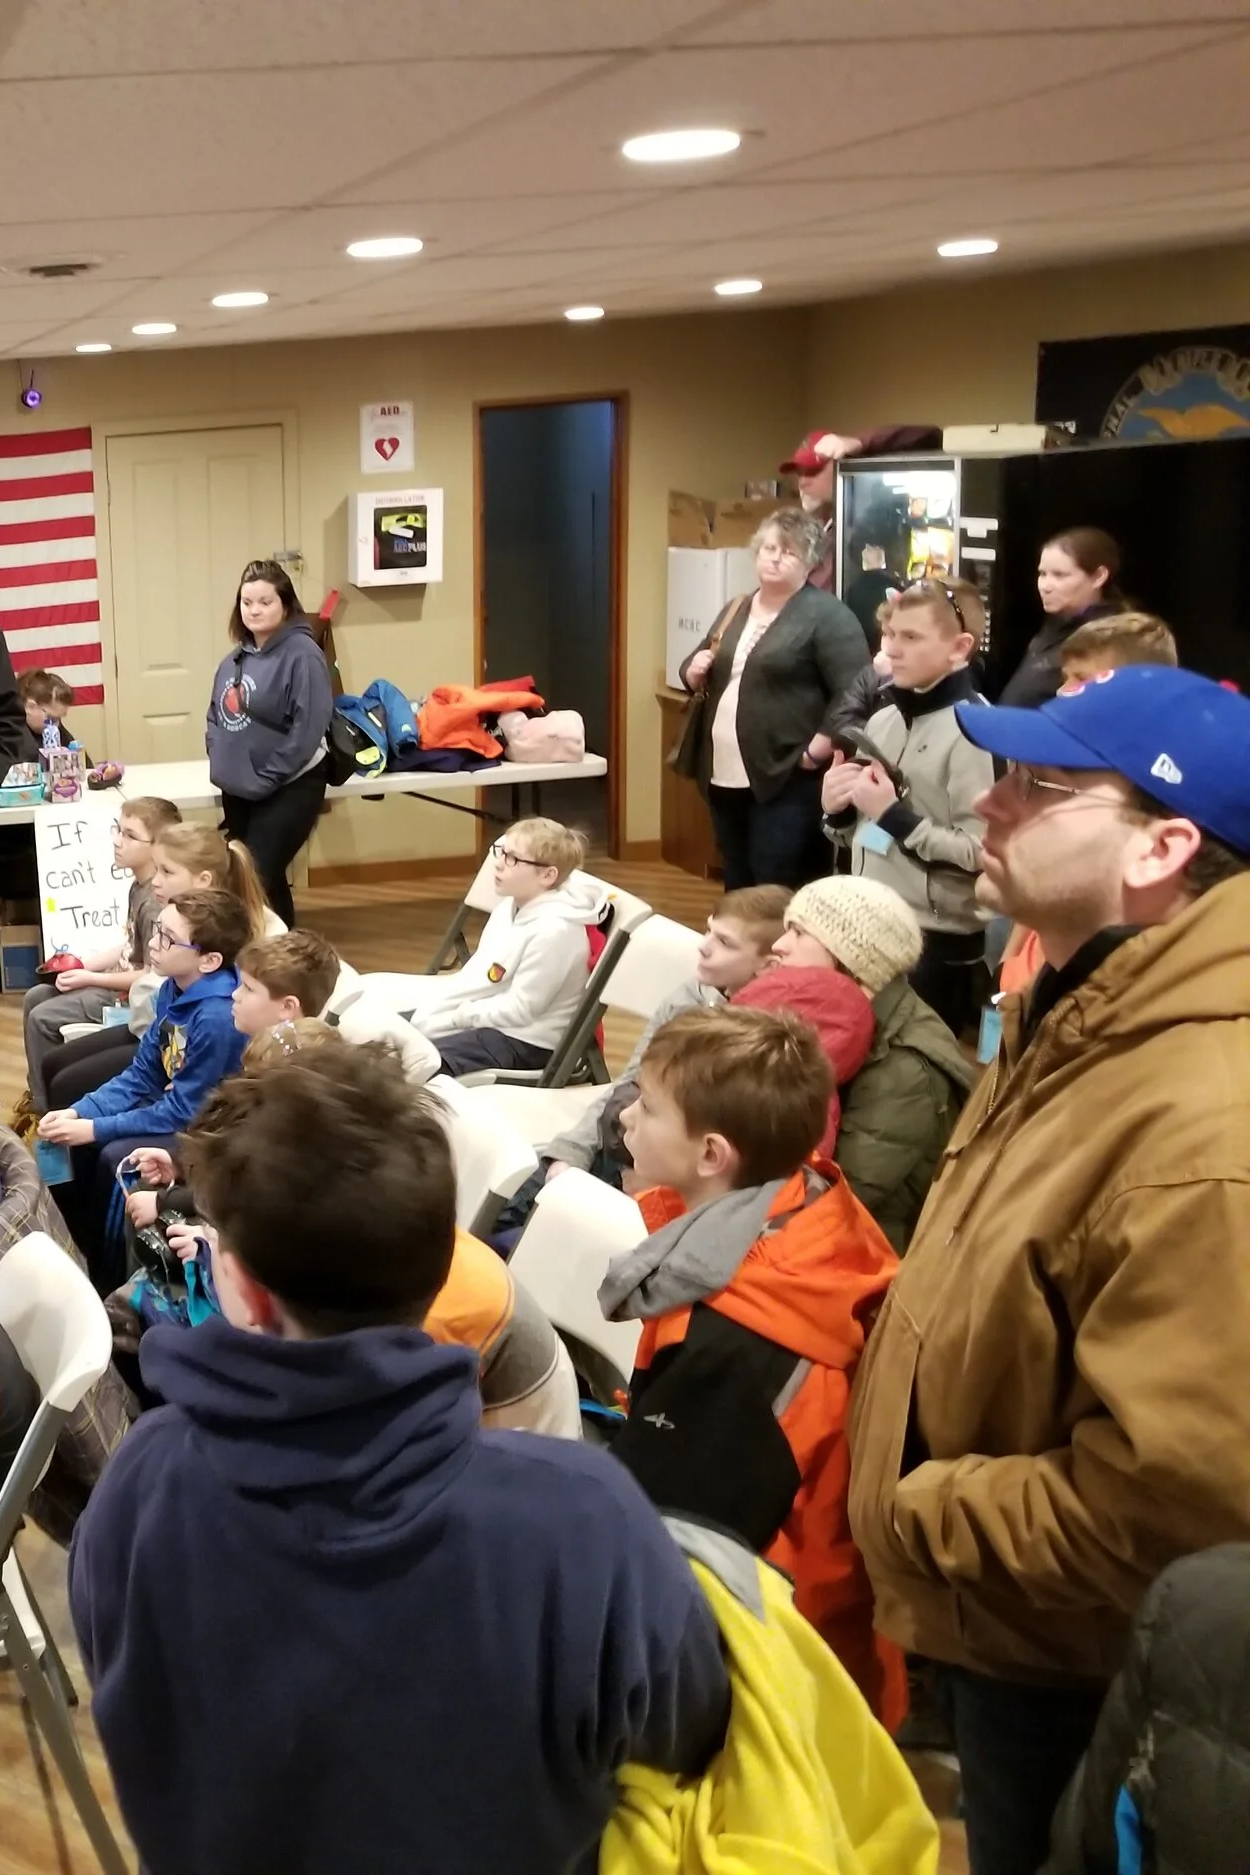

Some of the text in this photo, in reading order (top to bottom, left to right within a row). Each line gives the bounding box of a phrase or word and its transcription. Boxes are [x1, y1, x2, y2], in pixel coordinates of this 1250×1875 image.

[380, 405, 400, 416] AED
[47, 820, 88, 850] If
[45, 860, 135, 889] can't ea
[60, 898, 120, 929] Treat
